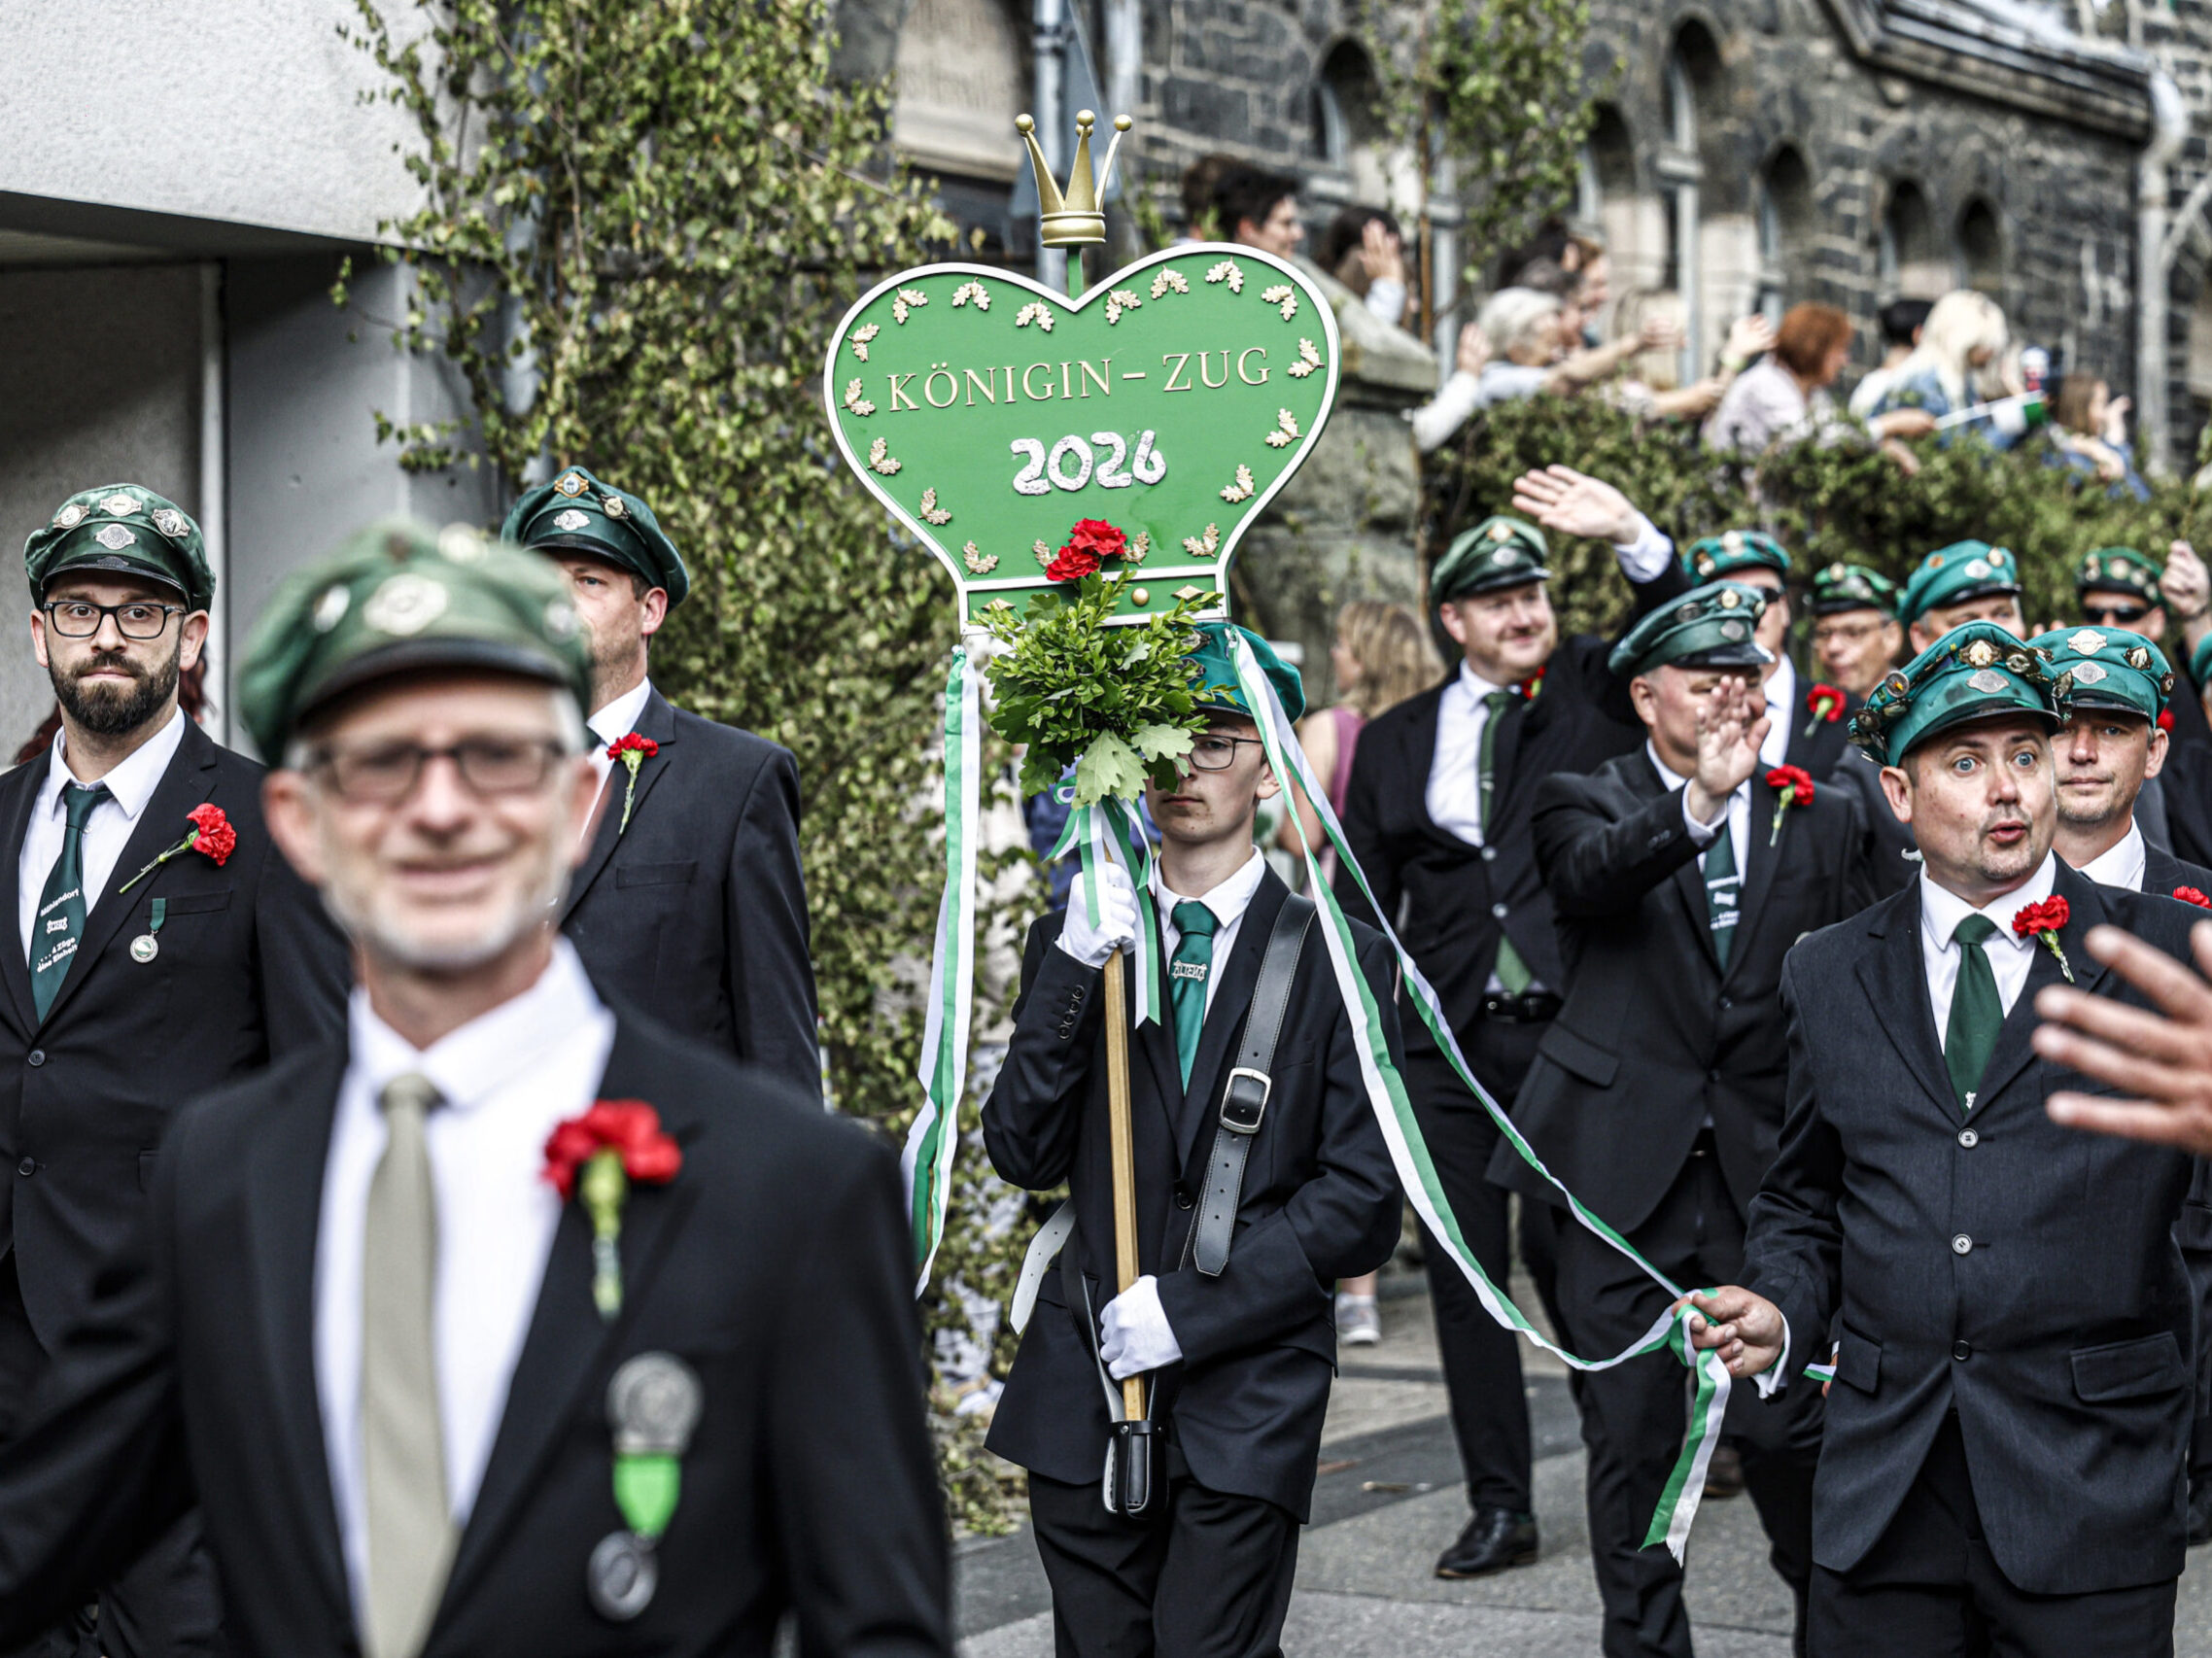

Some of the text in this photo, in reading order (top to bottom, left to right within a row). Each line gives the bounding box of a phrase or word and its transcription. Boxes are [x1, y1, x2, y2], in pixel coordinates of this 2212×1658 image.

[886, 358, 1112, 412] KÖNIGIN
[1162, 347, 1272, 393] ZUG
[1010, 430, 1167, 497] 2026
